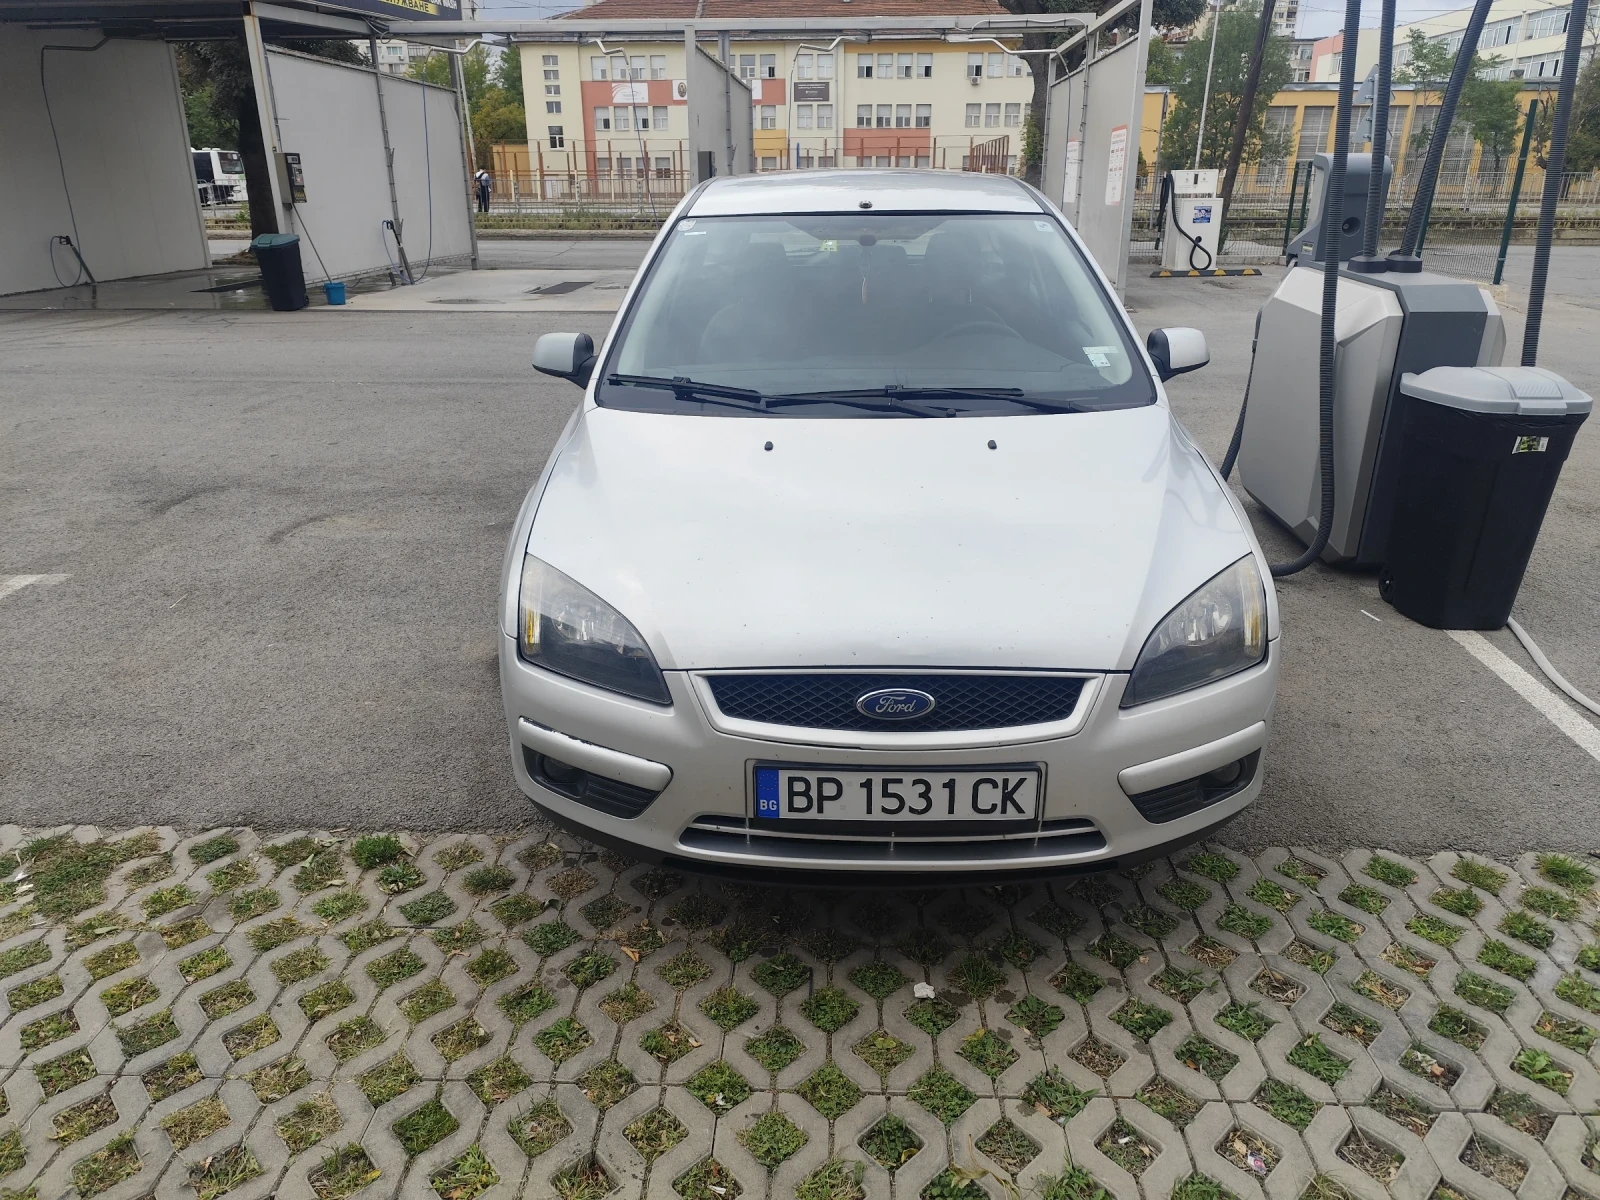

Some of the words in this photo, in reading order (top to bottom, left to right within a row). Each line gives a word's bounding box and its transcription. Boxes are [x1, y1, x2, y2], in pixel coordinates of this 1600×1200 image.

[875, 695, 917, 713] Ford
[787, 776, 844, 815] BP
[859, 777, 957, 815] 1531
[971, 777, 1028, 815] CK
[759, 799, 778, 811] BG
